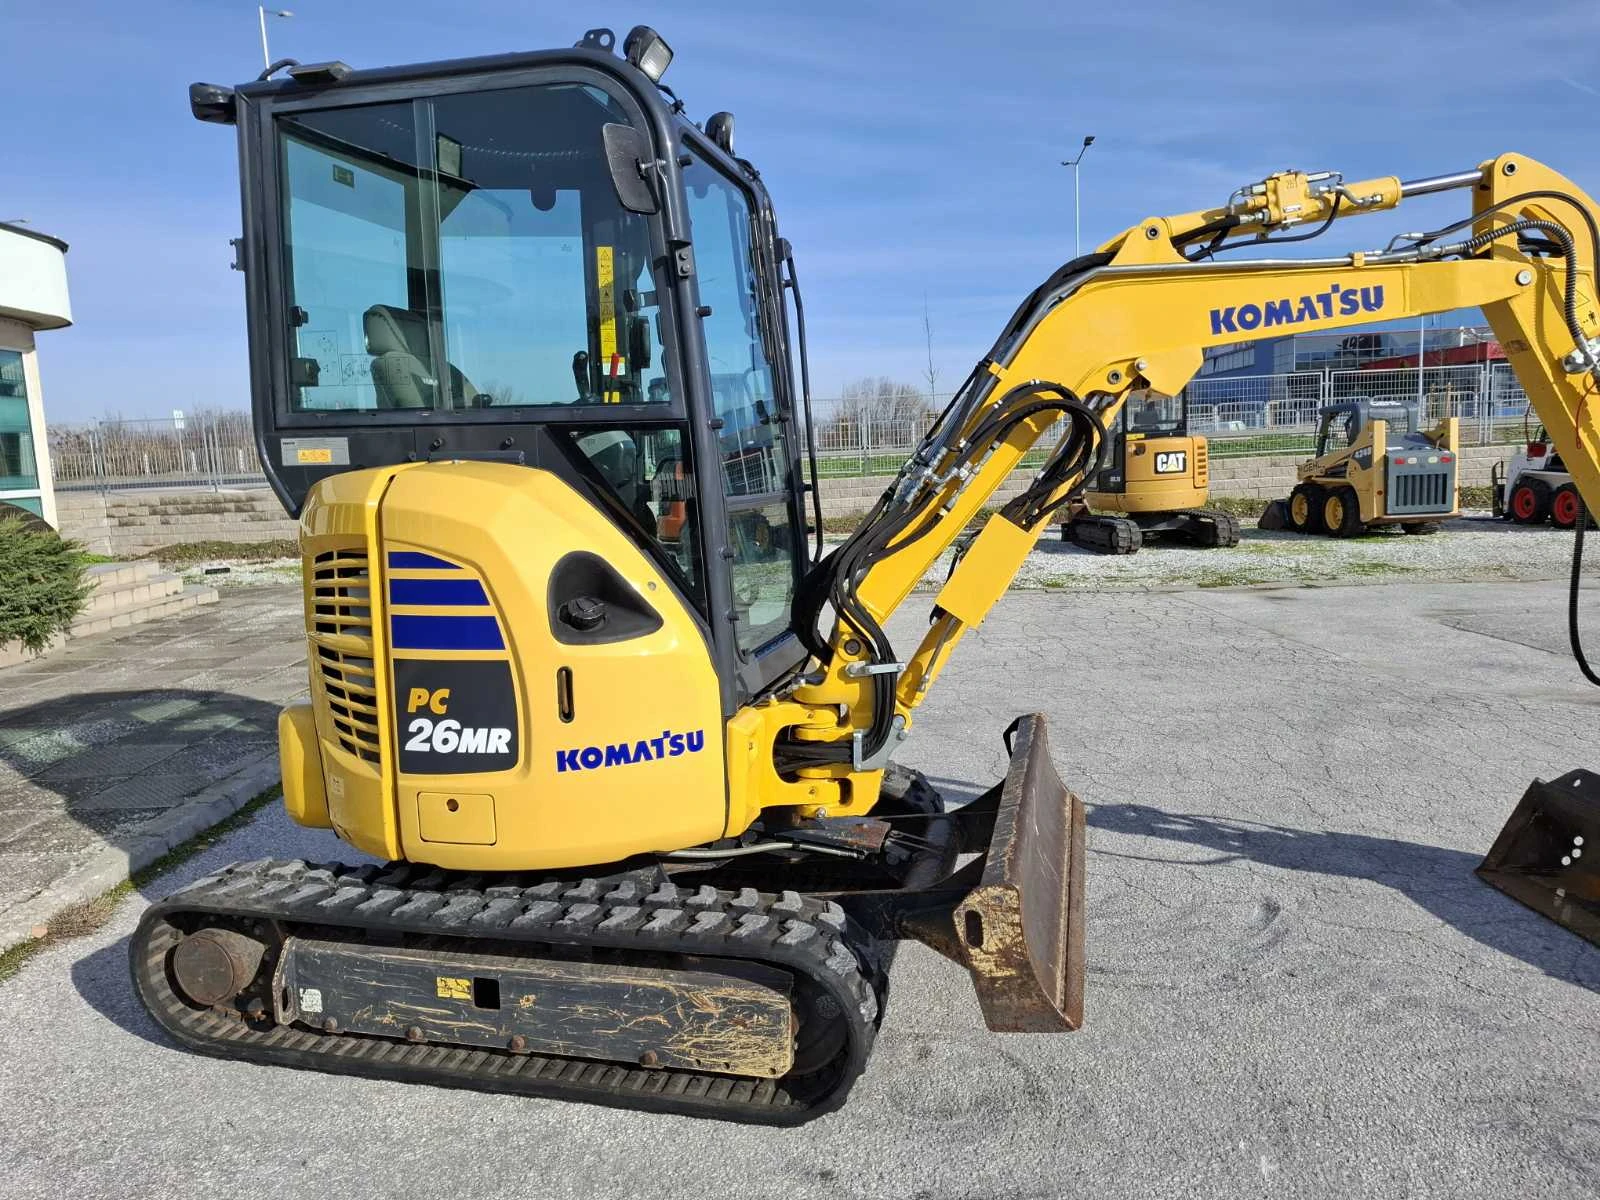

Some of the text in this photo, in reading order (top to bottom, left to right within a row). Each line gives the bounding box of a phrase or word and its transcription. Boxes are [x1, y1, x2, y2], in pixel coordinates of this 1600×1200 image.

[1210, 284, 1384, 335] KOMATSU
[1157, 453, 1184, 472] CAT
[407, 687, 450, 715] PC
[405, 718, 512, 753] 26MR
[556, 730, 704, 772] KOMATSU
